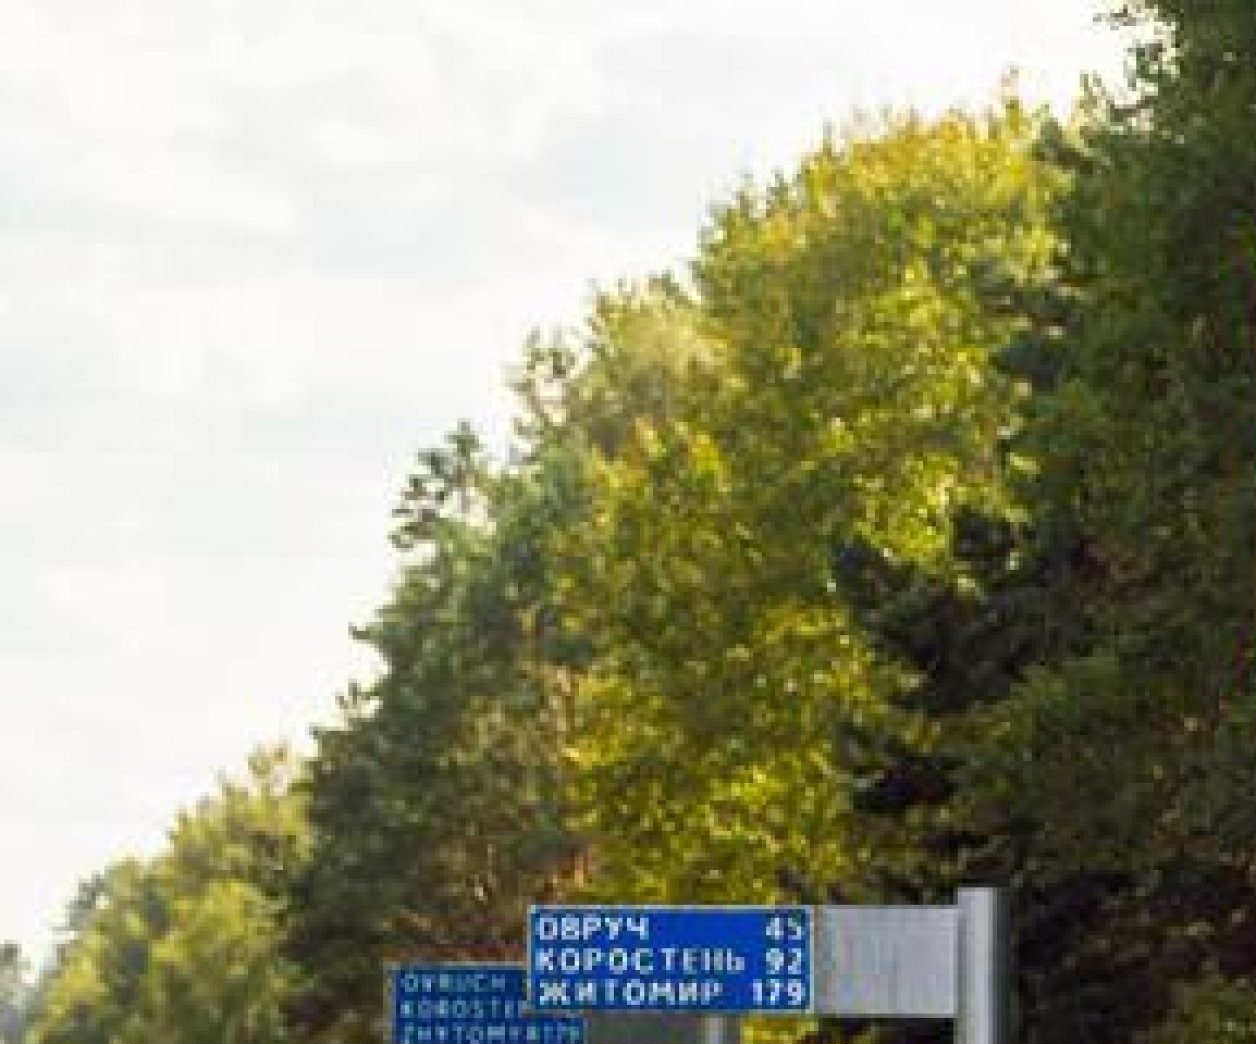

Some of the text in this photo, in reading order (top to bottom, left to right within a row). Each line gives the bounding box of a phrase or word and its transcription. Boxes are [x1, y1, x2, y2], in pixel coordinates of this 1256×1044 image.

[538, 914, 804, 941] ОВРУЧ 45
[536, 948, 804, 975] КОРОСТЕНЬ 92
[539, 980, 805, 1006] ЖИТОМИР 179
